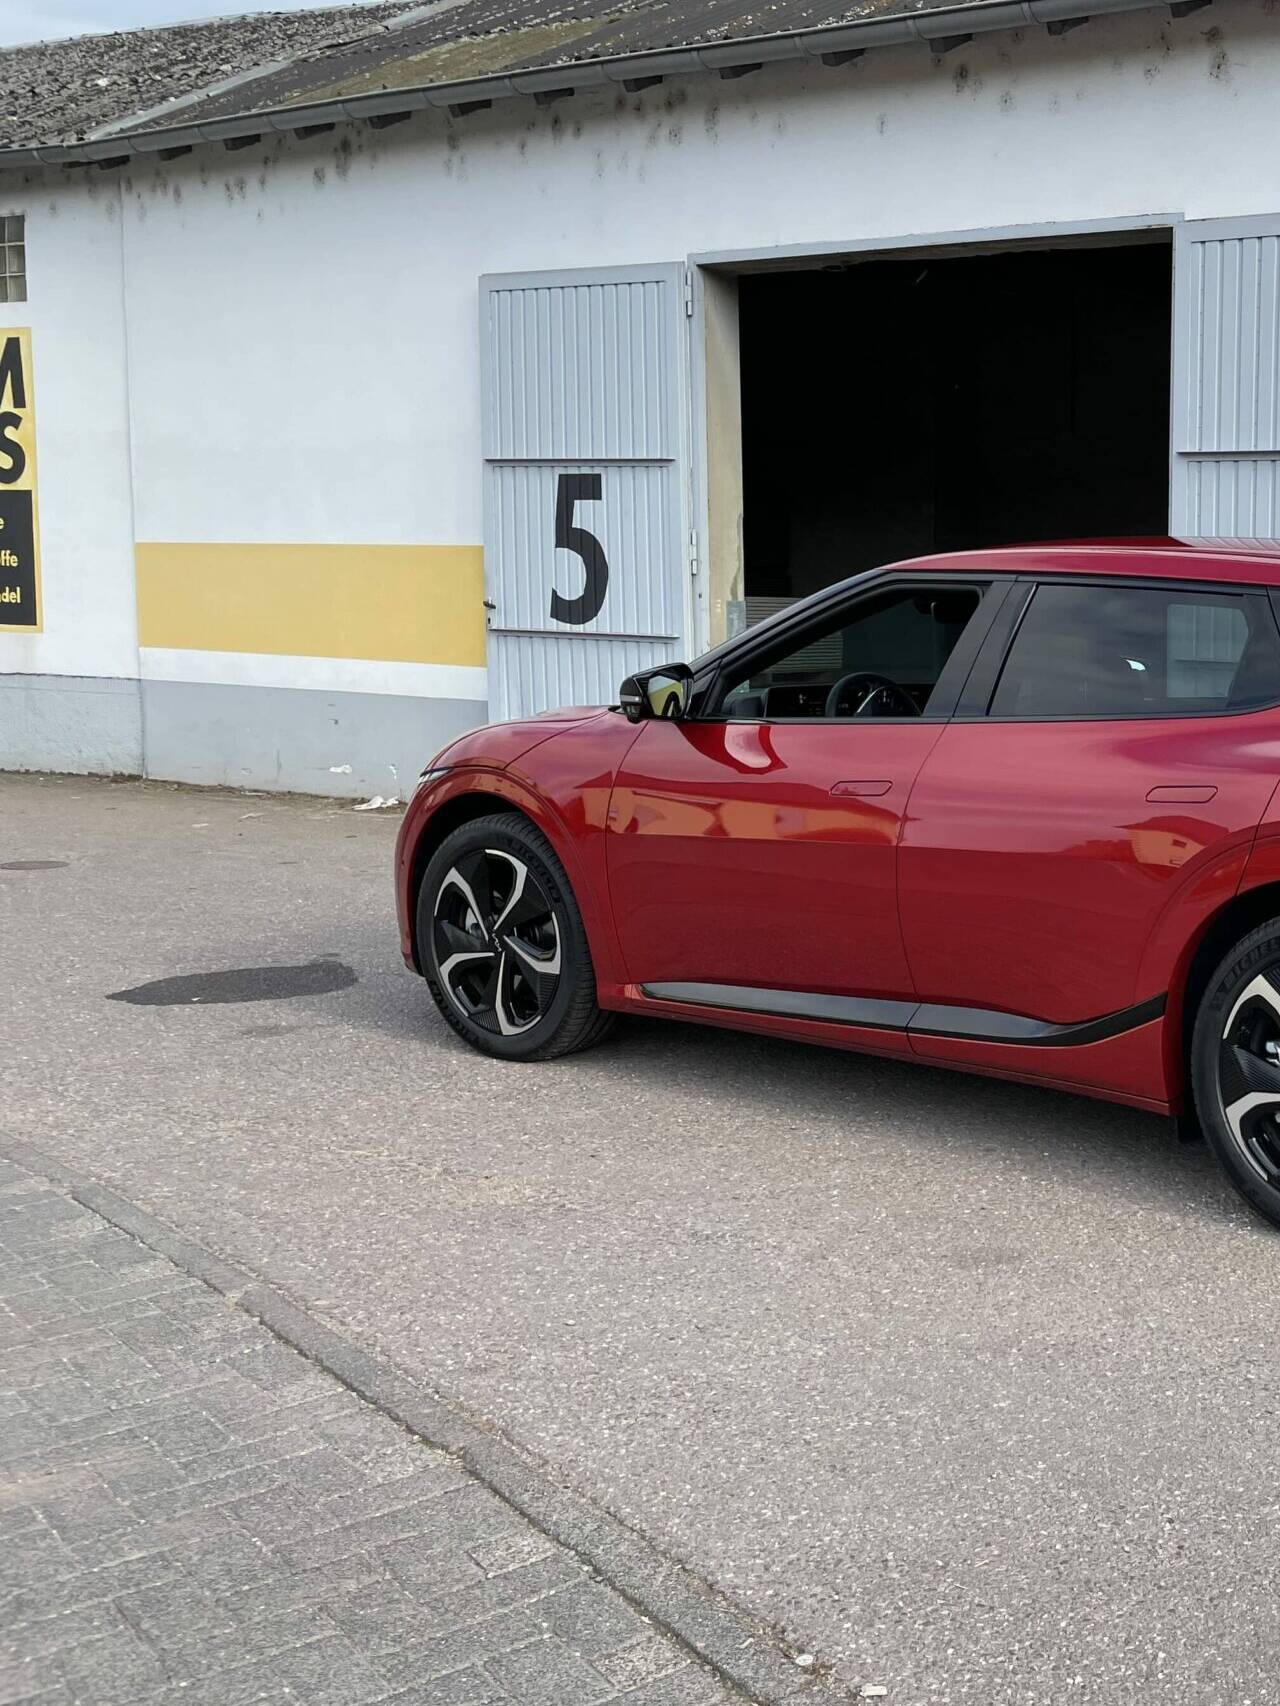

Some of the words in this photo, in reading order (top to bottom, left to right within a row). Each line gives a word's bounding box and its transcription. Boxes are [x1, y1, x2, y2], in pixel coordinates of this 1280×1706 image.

[0, 549, 19, 567] ffe
[550, 473, 609, 625] 5
[0, 586, 21, 603] del
